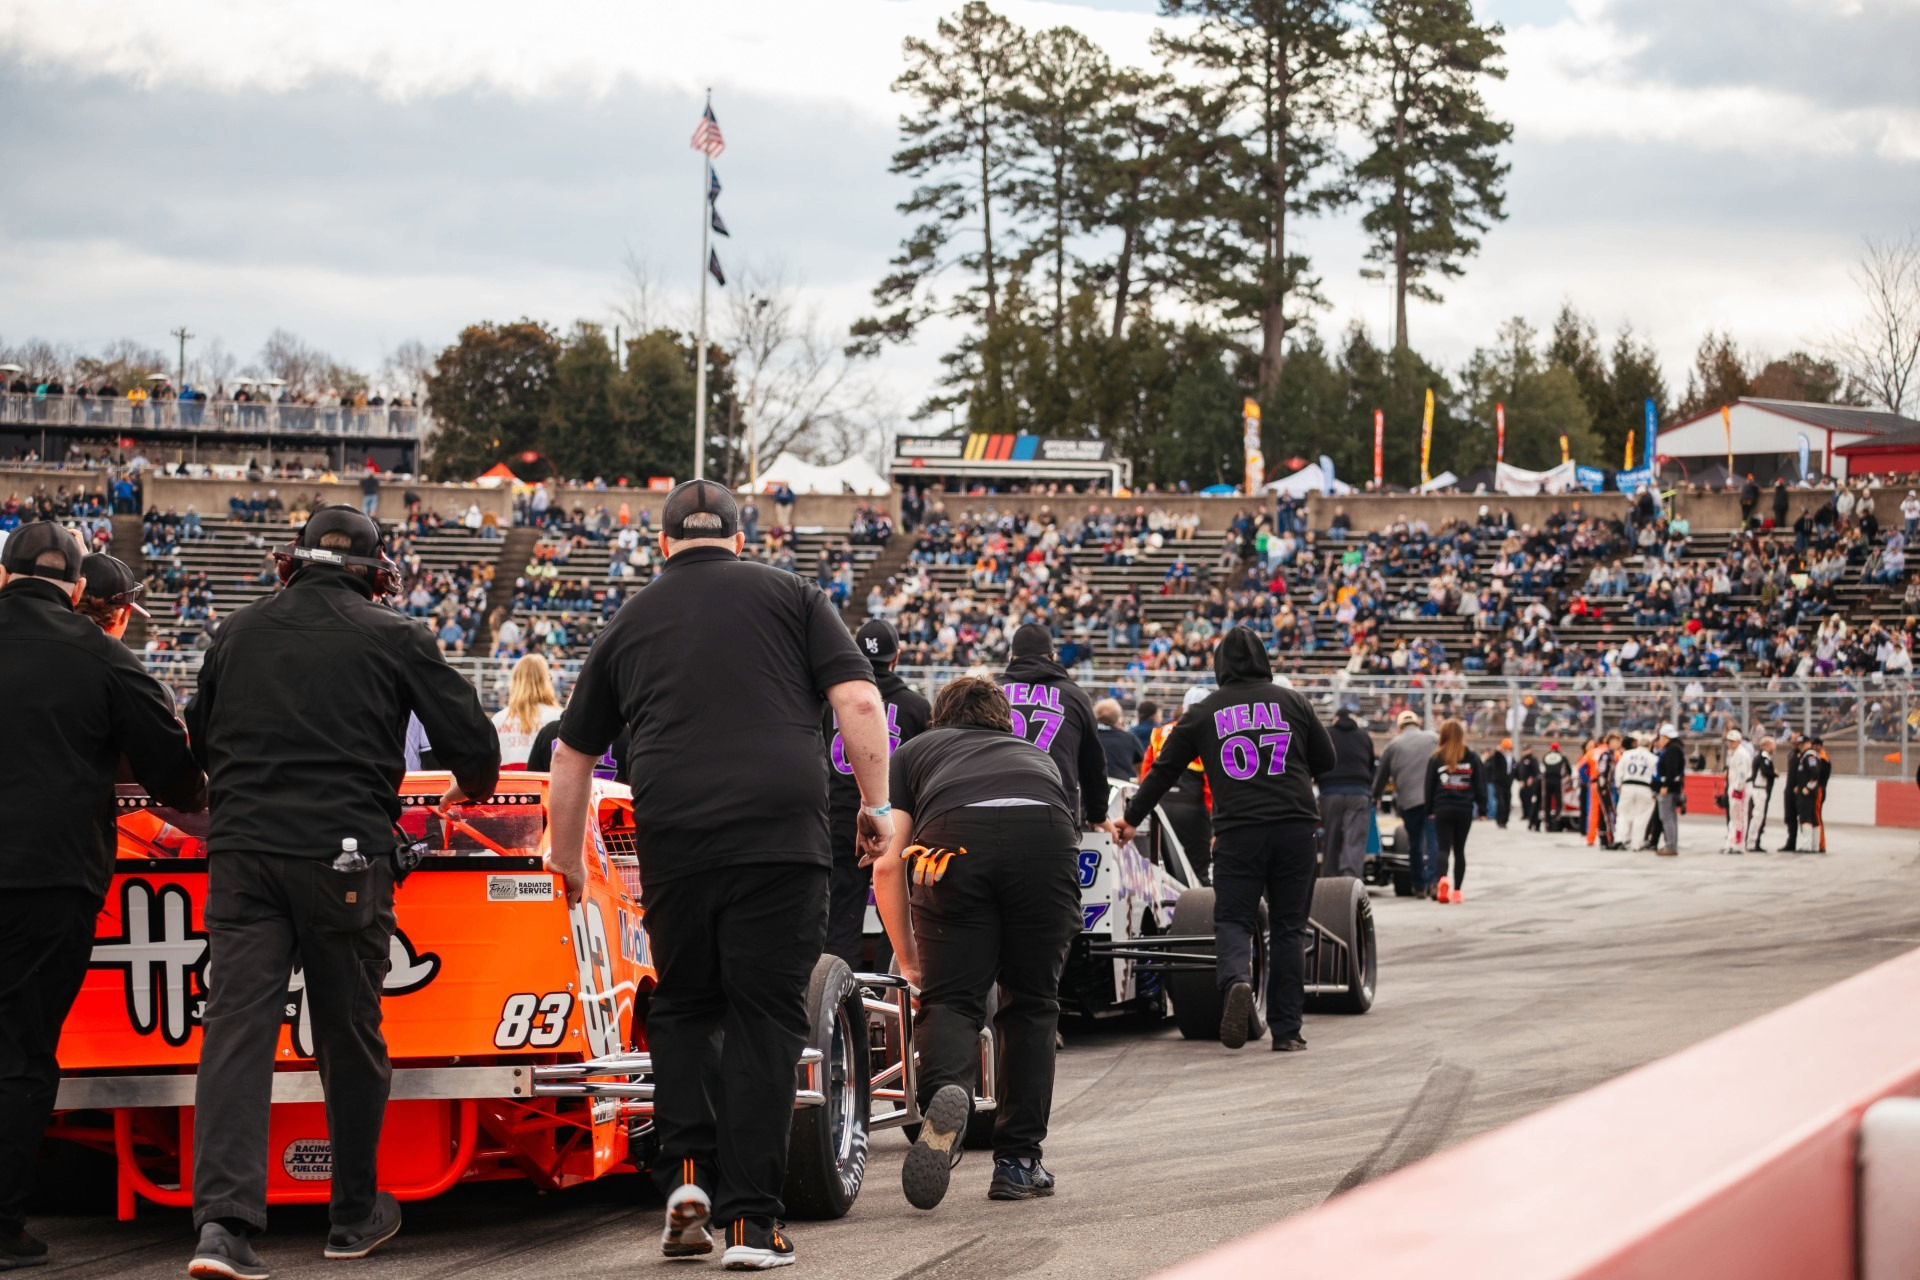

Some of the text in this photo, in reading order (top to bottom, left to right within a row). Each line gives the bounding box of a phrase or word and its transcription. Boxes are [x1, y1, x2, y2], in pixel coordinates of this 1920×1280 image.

[1213, 702, 1290, 740] NEAL
[1220, 732, 1293, 780] 07
[569, 896, 621, 1059] 83
[494, 991, 575, 1050] 83
